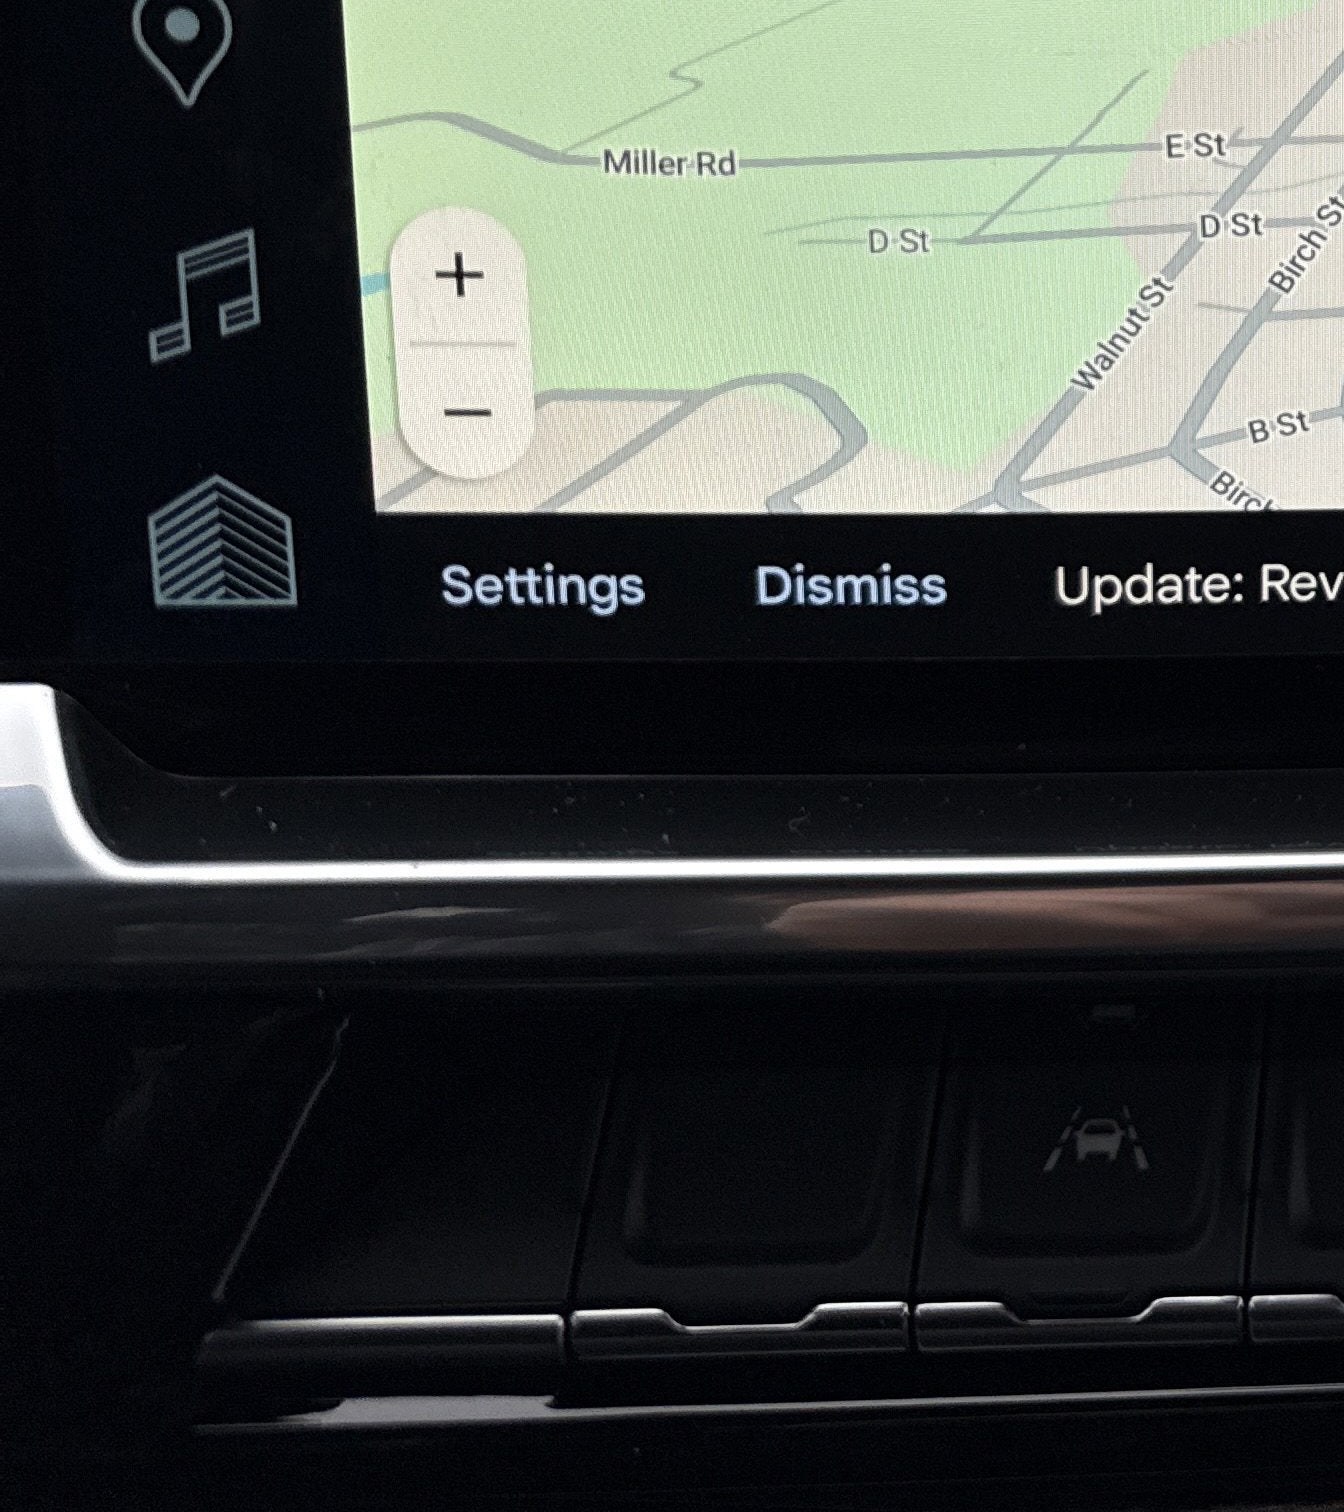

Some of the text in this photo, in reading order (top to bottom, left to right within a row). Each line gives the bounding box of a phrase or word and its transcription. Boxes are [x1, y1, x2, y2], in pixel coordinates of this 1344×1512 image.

[603, 150, 736, 177] Miller Rd
[1166, 133, 1226, 159] E St
[867, 229, 930, 253] D St
[1201, 213, 1262, 238] D St
[1268, 230, 1327, 295] Birch
[1071, 276, 1174, 391] Walnut St
[1249, 411, 1310, 443] B St
[442, 562, 645, 615] Settings
[757, 562, 946, 606] Dismiss
[1056, 564, 1244, 615] Update:
